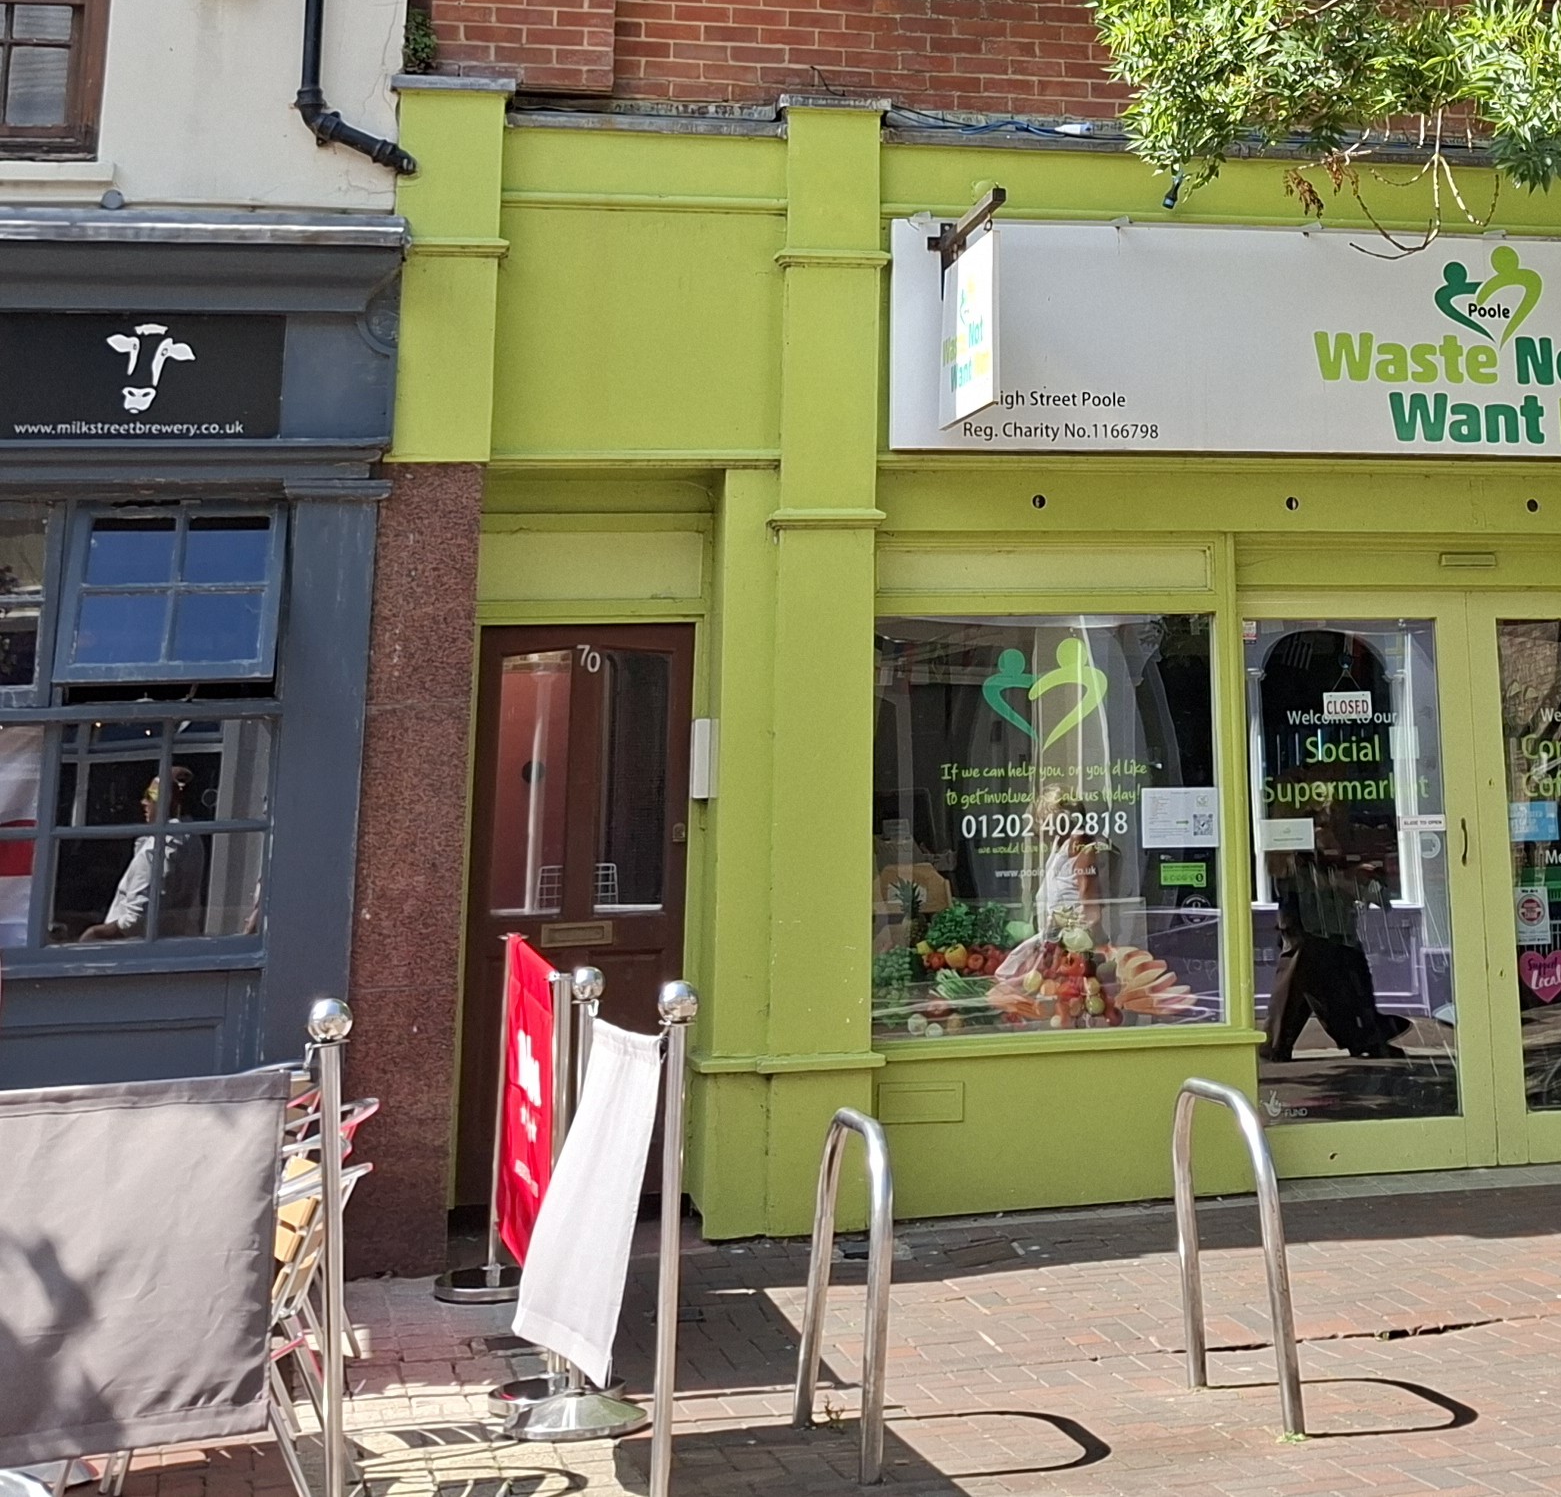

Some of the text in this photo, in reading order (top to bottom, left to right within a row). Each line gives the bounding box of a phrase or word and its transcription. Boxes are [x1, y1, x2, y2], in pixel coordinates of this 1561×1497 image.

[1468, 303, 1510, 319] Poole
[1314, 331, 1498, 384] Waste
[996, 391, 1126, 410] igh Street Poole
[14, 421, 244, 437] www.milkstreetbrewery.co.uk
[1389, 392, 1545, 444] Want
[963, 422, 1159, 442] Reg. Charity No.1166798
[577, 645, 600, 672] 70
[1326, 699, 1370, 715] CLOSED
[1374, 711, 1398, 724] our
[1306, 734, 1380, 763] Social
[941, 763, 958, 780] If
[961, 768, 980, 779] we
[983, 767, 1005, 778] can
[1008, 761, 1035, 783] help
[946, 787, 958, 806] to
[961, 789, 981, 810] get
[1085, 790, 1099, 801] us
[1263, 772, 1429, 809] Supermart
[962, 814, 1035, 839] 01202
[1040, 811, 1128, 837] 402818
